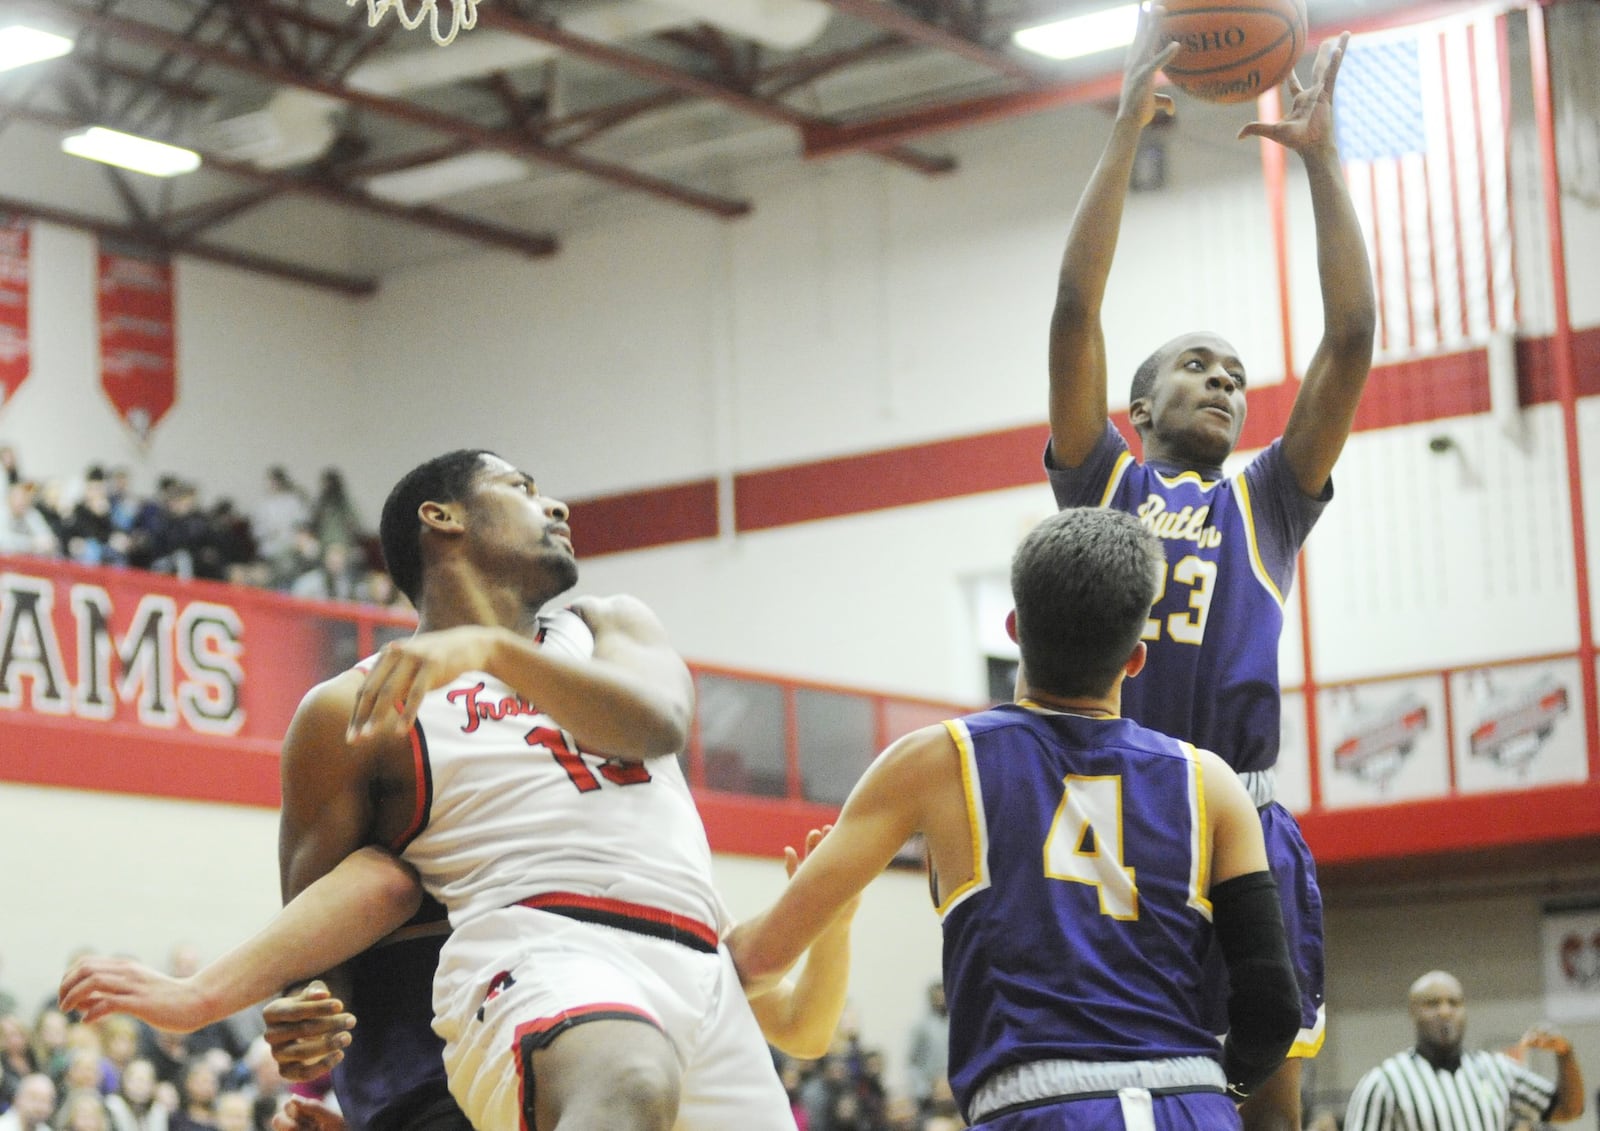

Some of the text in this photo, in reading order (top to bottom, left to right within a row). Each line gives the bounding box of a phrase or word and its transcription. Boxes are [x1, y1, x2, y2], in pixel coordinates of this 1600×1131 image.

[0, 572, 247, 737] AMS
[1140, 555, 1218, 647] 23
[1043, 774, 1140, 921] 4
